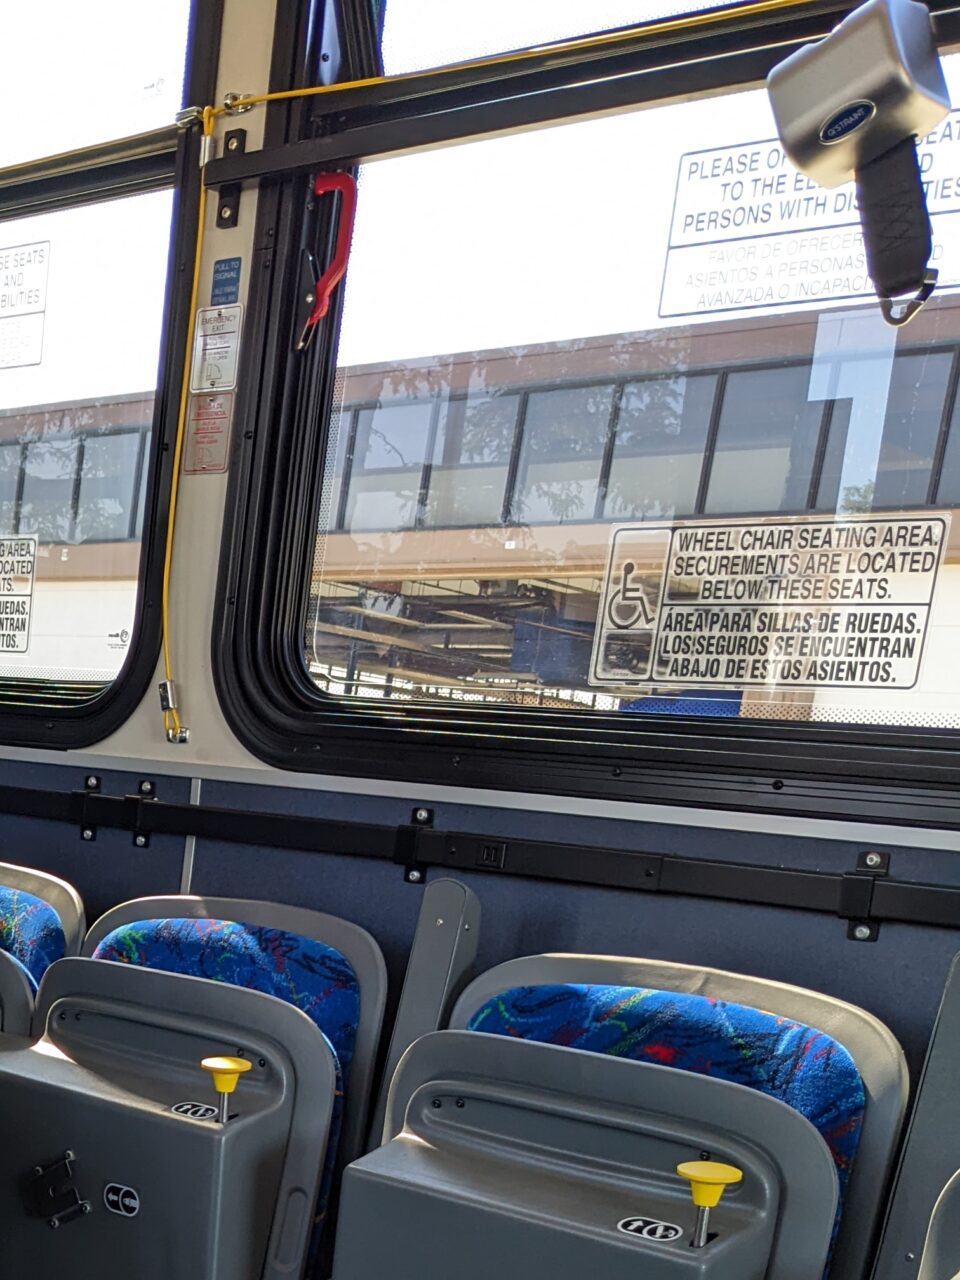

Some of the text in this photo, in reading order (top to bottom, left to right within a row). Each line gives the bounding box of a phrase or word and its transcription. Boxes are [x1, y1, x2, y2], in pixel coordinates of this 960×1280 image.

[688, 152, 761, 181] PLEASE
[721, 180, 744, 202] TO
[751, 174, 786, 198] THE
[683, 203, 773, 233] PERSONS
[779, 194, 826, 220] WITH
[13, 249, 45, 266] SEATS
[708, 232, 864, 264] FAVOR DE OFRECER
[214, 271, 237, 280] SIGNAL
[230, 261, 239, 269] TO
[685, 253, 864, 288] ASIENTOS A PERSONAS
[3, 272, 24, 287] AND
[697, 286, 774, 308] AVANZADA
[778, 283, 790, 298] O
[201, 315, 236, 325] EMERGENCY
[7, 543, 33, 557] AREA.
[679, 525, 939, 552] WHEEL CHAIR SEATING AREA.
[674, 552, 934, 576] SECUREMENTS ARE LOCATED
[701, 578, 891, 600] BELOW THESE SEATS.
[662, 607, 920, 634] ÁREA PARA SILLAS DE RUEDAS.
[662, 636, 916, 658] LOS SEGUROS SE ENCUENTRAN
[669, 658, 896, 683] ABAJO DE ESTOS ASIENTOS.
